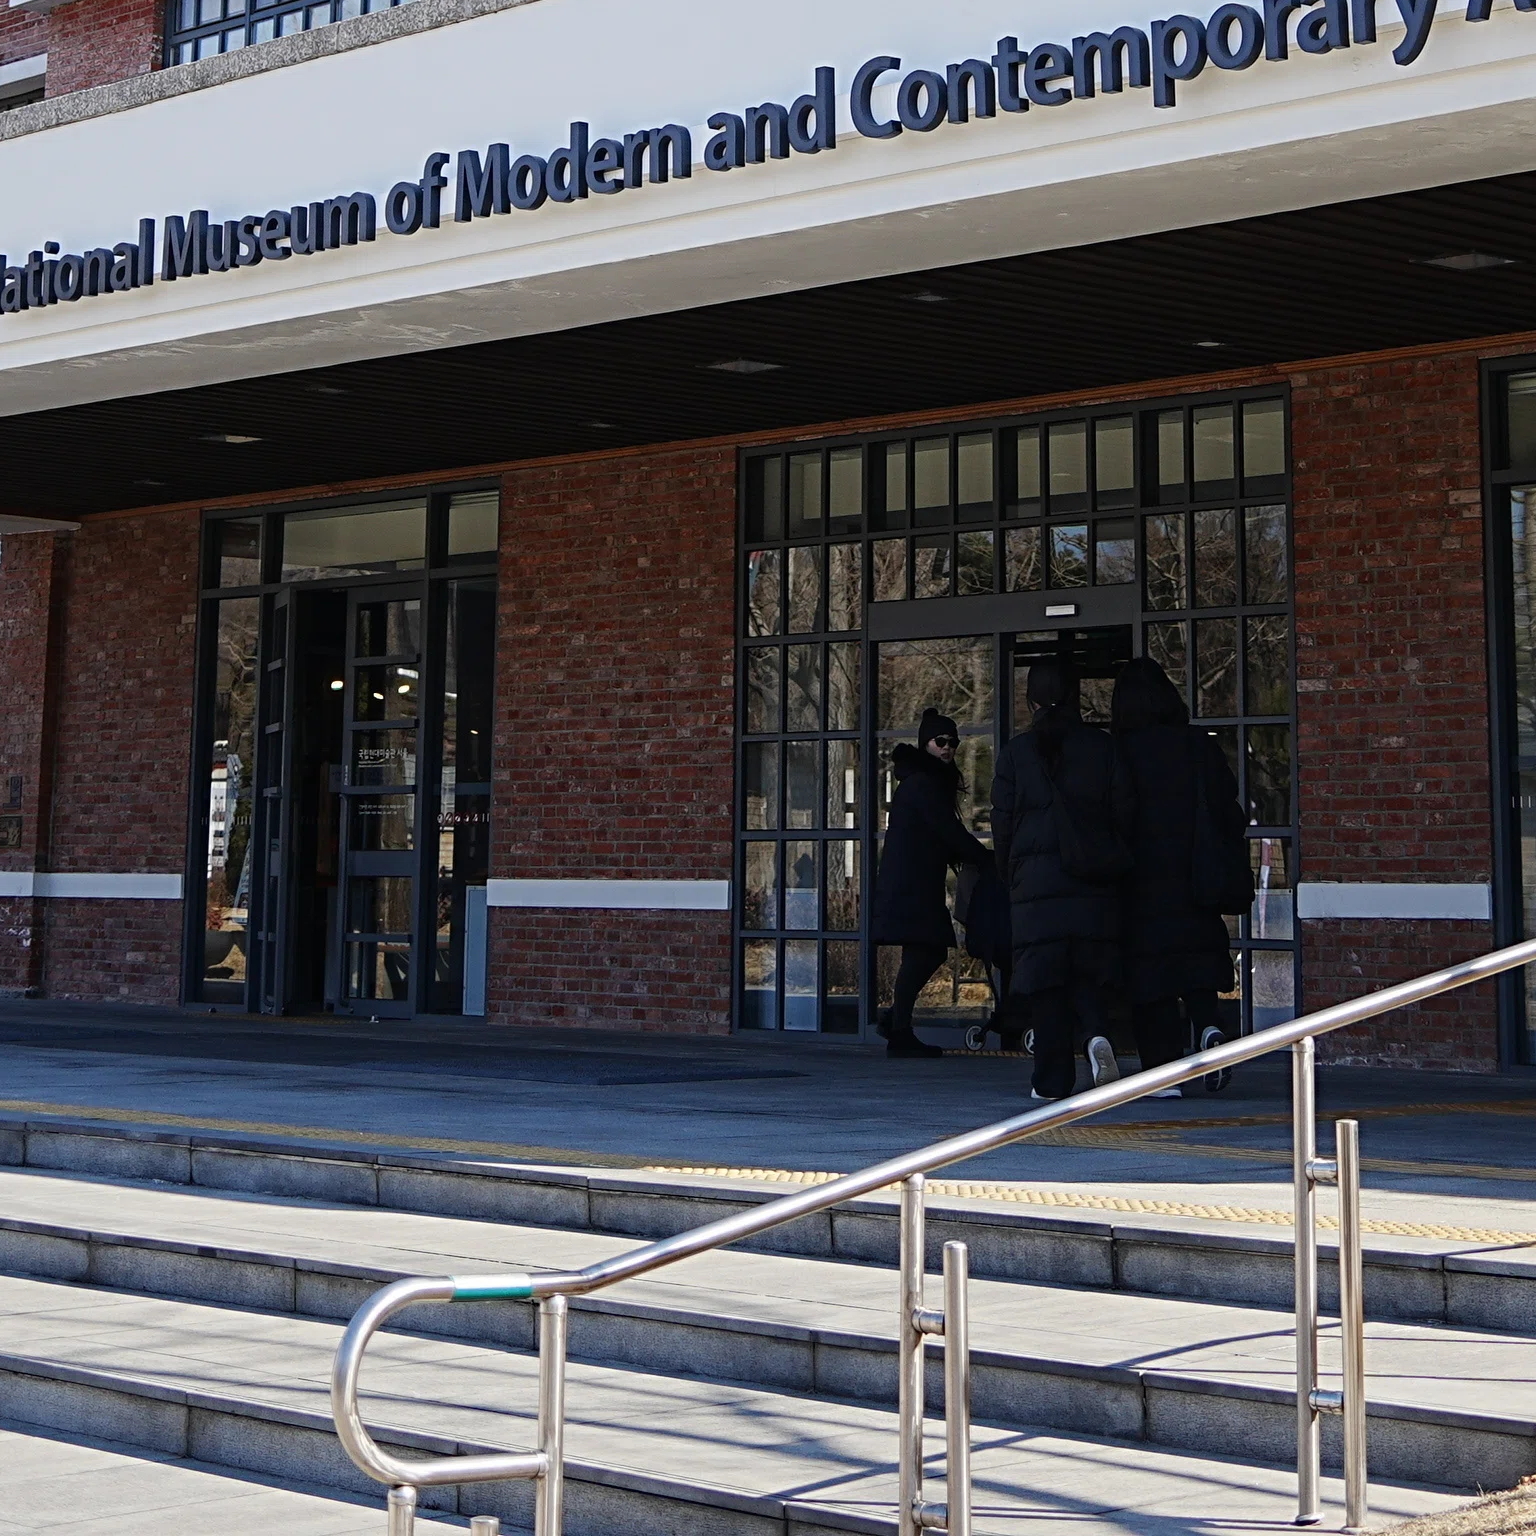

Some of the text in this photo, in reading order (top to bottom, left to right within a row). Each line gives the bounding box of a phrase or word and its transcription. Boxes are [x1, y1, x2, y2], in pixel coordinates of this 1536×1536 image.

[161, 192, 376, 281] Museum
[386, 153, 450, 235] of
[454, 122, 691, 223] Modern
[704, 66, 836, 171] and
